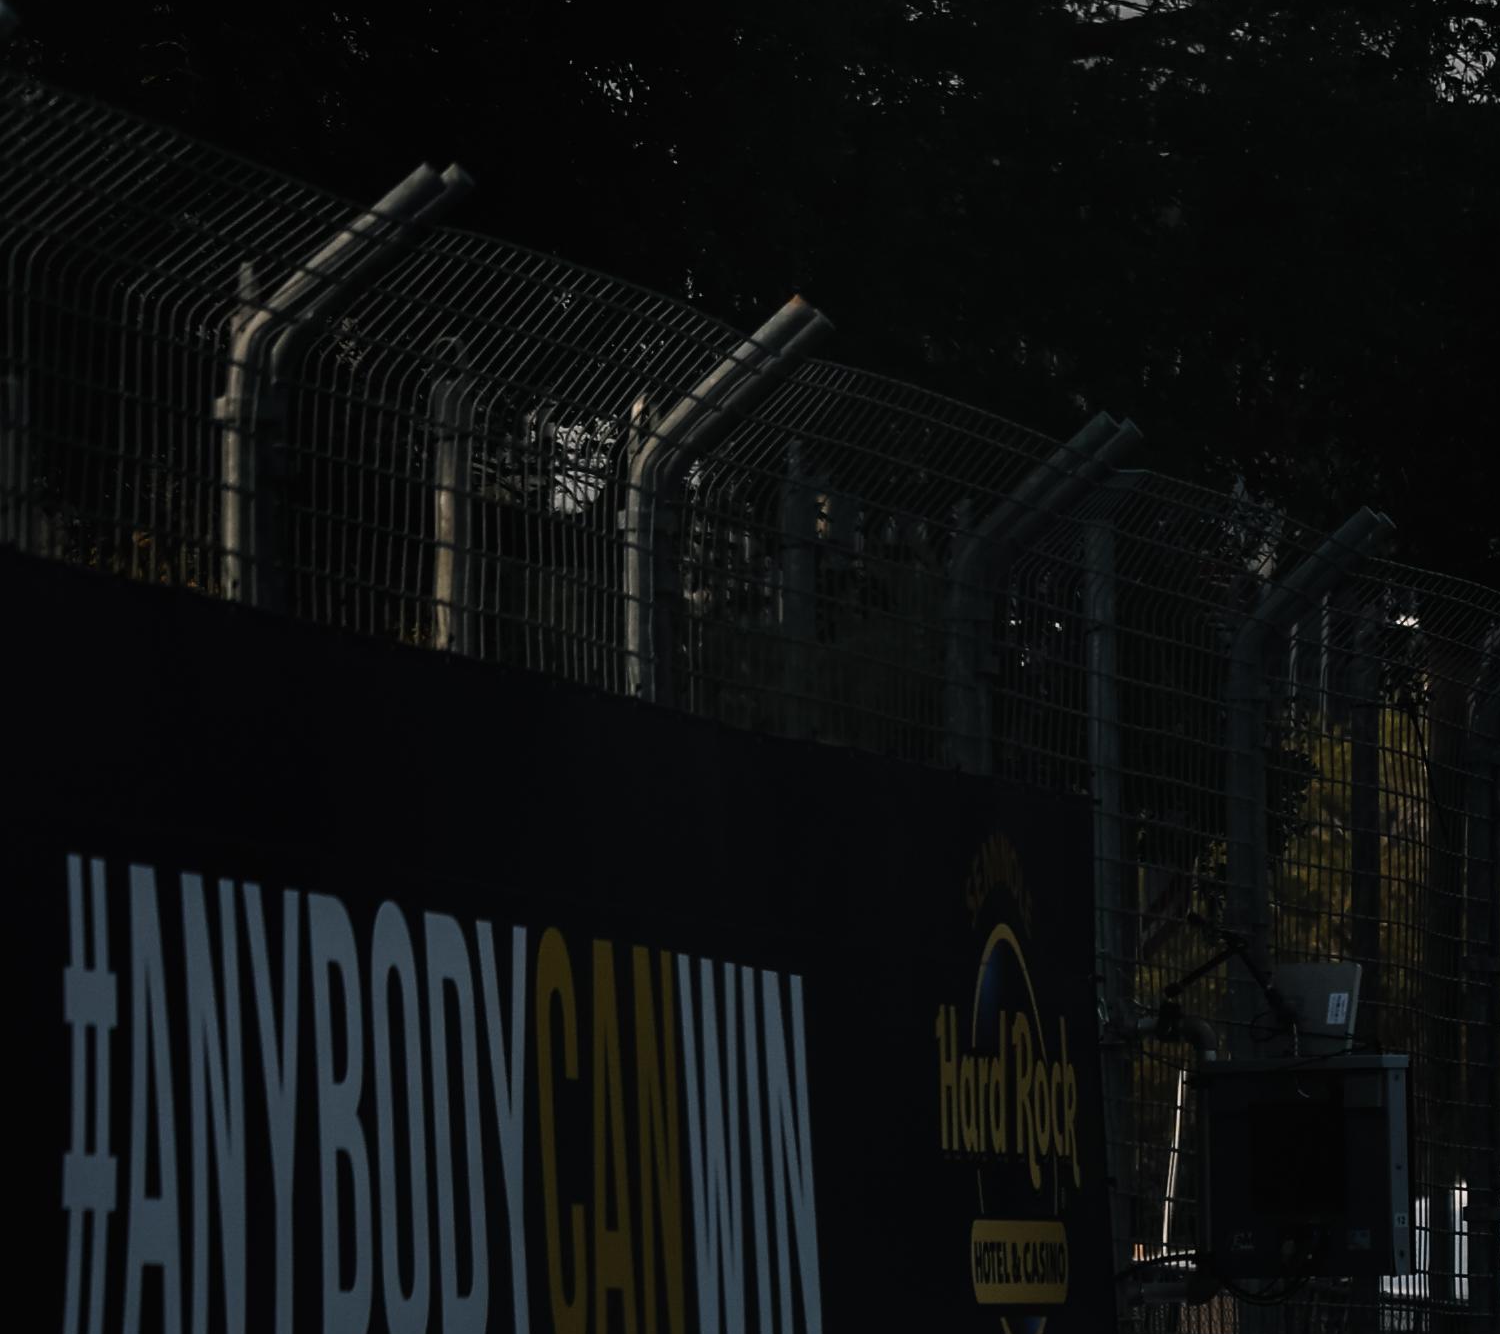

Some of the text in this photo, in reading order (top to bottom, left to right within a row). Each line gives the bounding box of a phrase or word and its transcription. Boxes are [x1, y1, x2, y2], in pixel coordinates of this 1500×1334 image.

[935, 1003, 1081, 1192] Hard Rock
[974, 1241, 1010, 1284] HOTEL
[1023, 1241, 1067, 1284] CASINO
